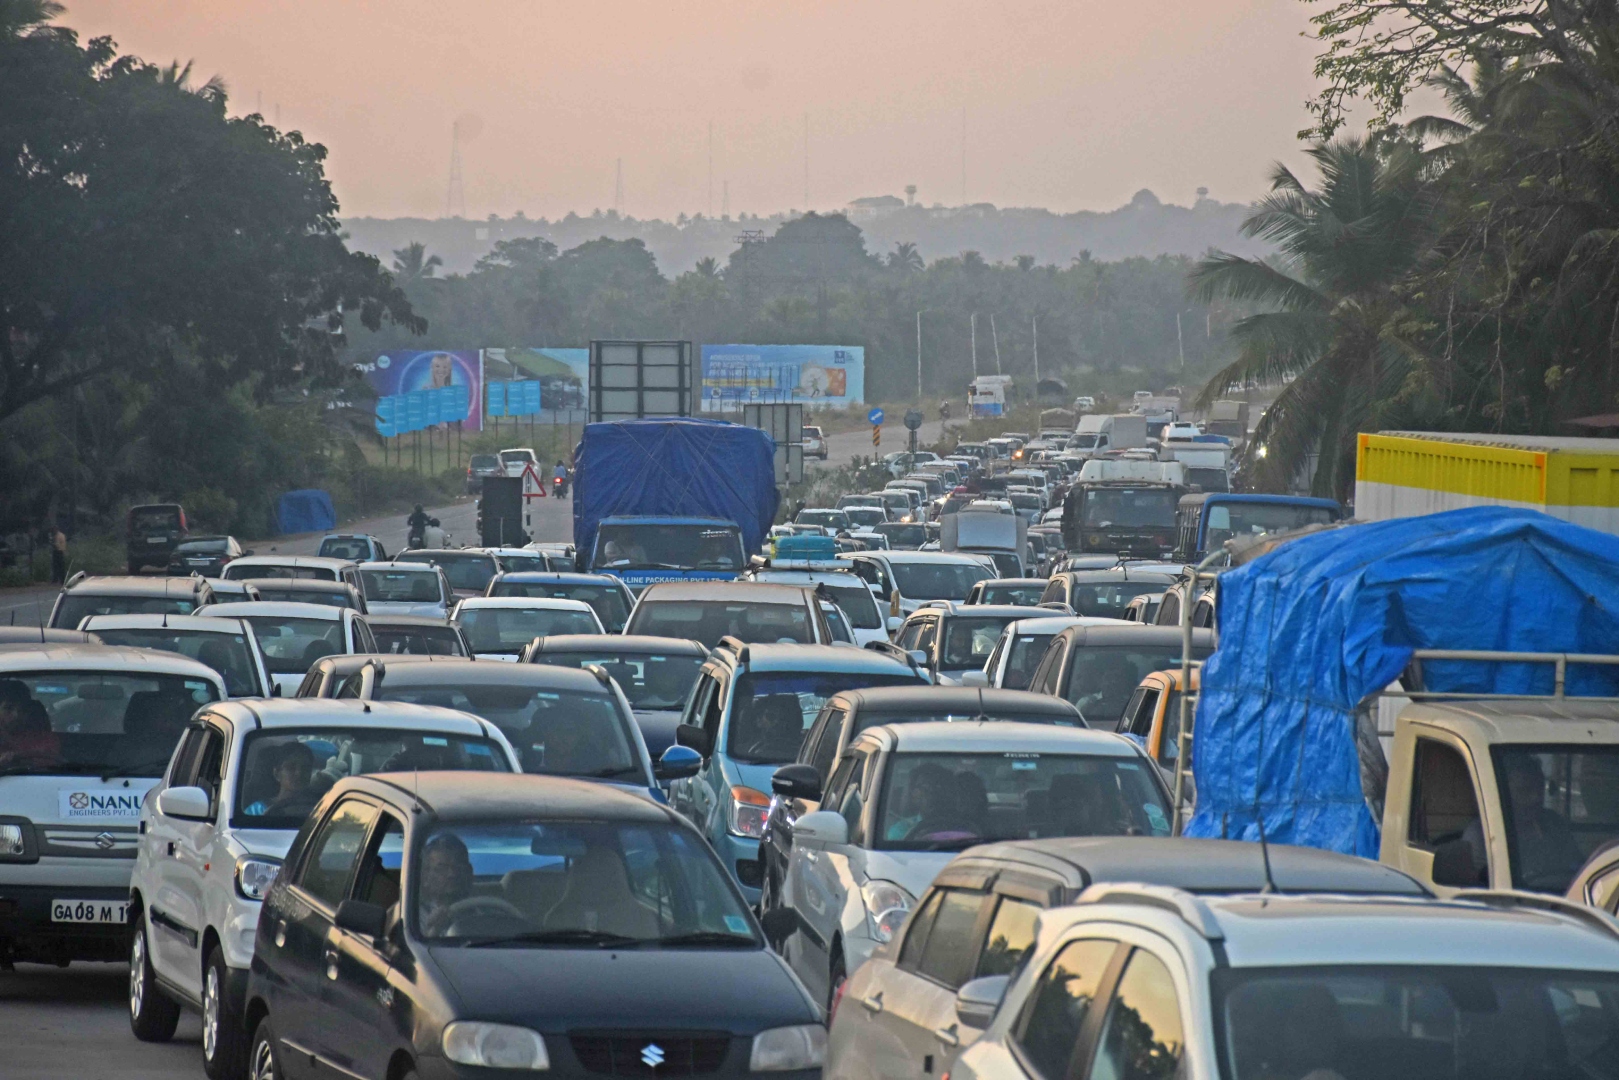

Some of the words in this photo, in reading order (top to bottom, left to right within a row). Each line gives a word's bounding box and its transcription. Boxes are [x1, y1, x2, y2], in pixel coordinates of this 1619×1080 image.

[353, 363, 376, 374] ays
[618, 576, 643, 584] N-LINE
[645, 576, 688, 584] PACKAGING
[69, 809, 111, 817] ENGINEERS
[112, 809, 129, 817] PVT.
[100, 906, 112, 922] M
